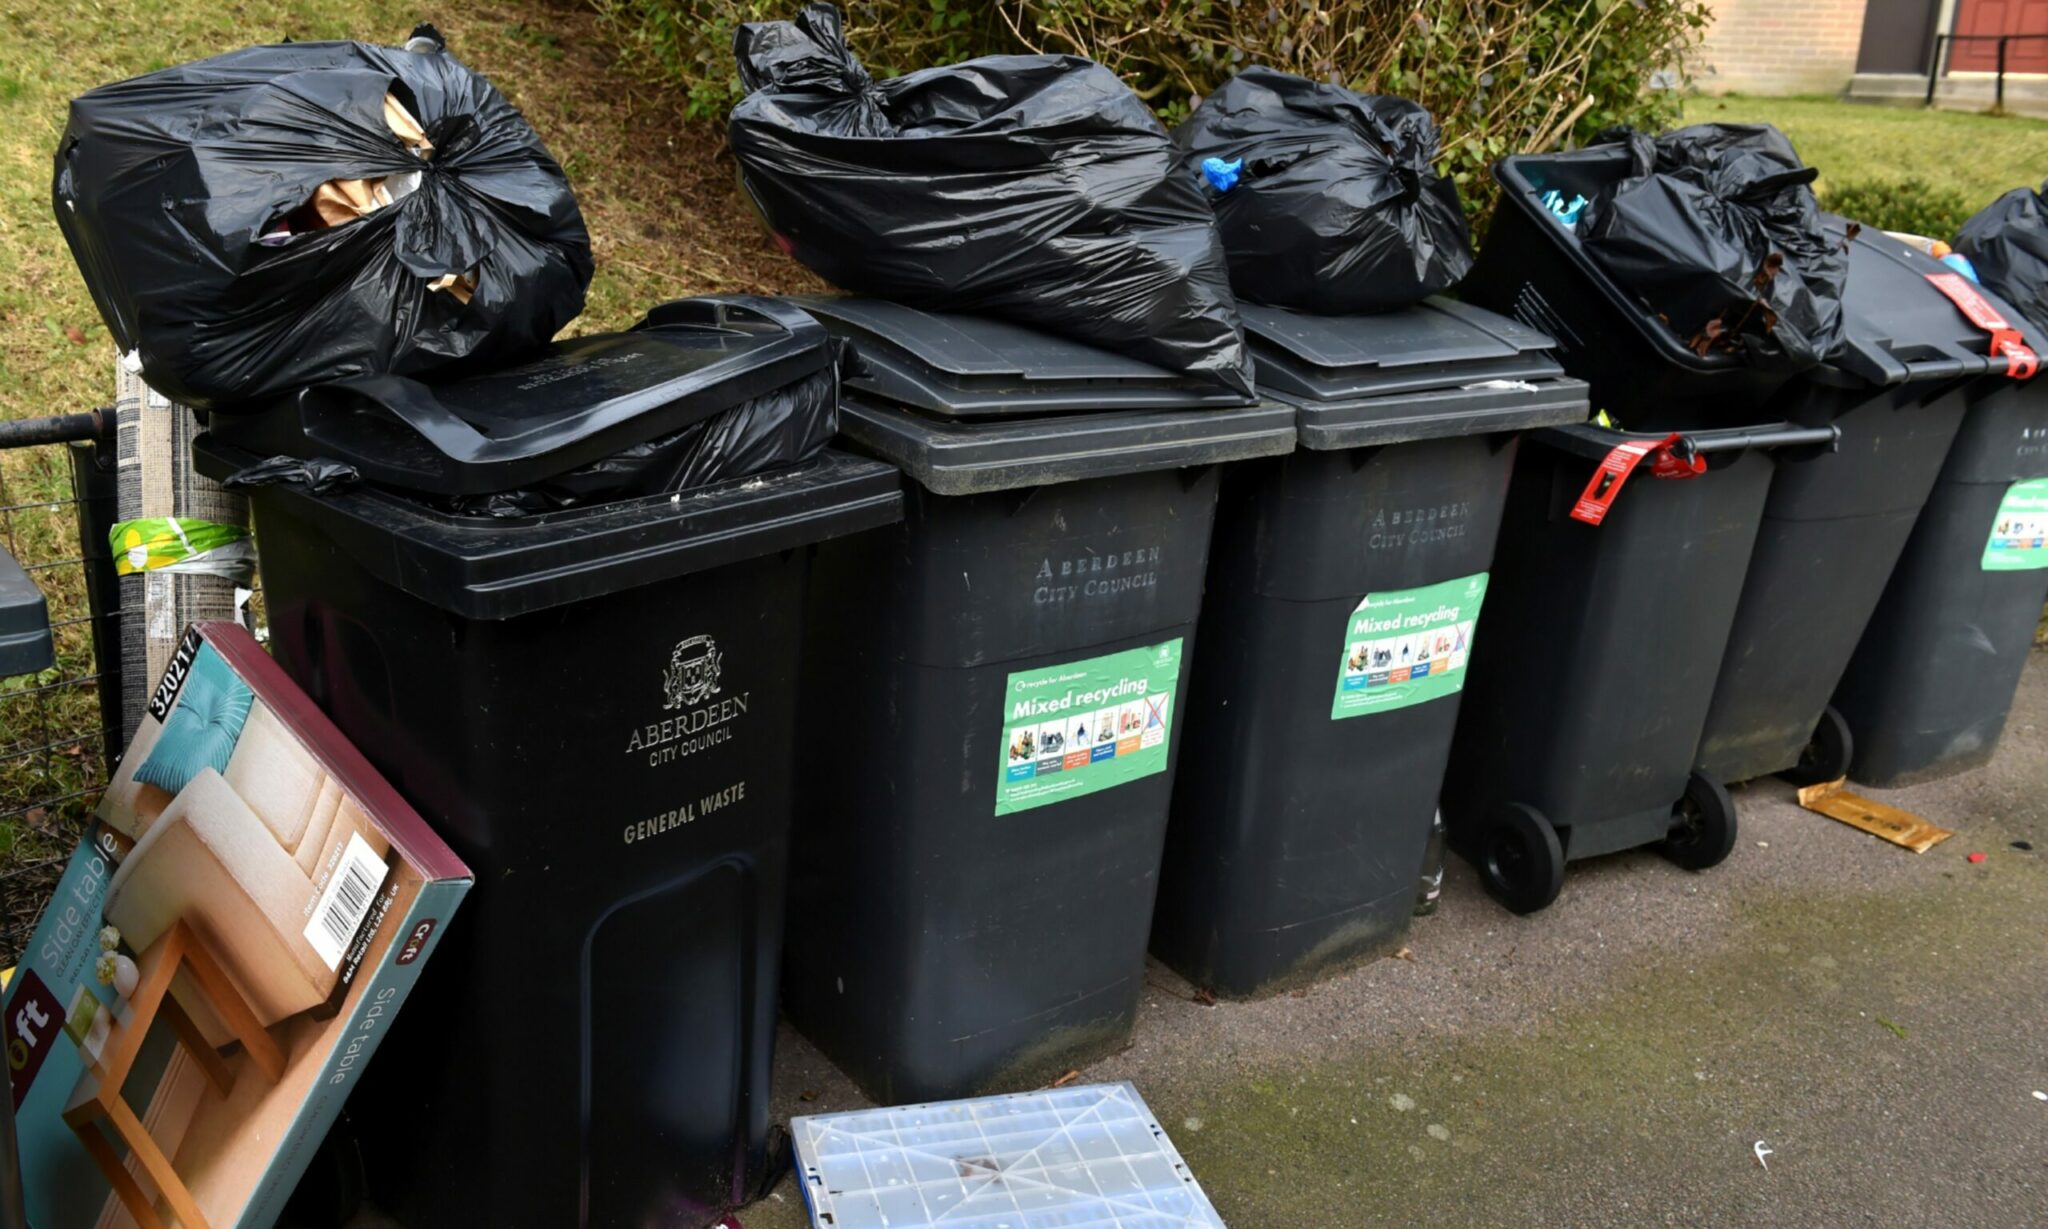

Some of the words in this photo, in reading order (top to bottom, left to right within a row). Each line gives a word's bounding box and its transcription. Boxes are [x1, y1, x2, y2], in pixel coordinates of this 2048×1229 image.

[1035, 546, 1160, 579] ABERDEEN
[1033, 585, 1078, 605] CITY
[1084, 571, 1158, 597] COUNCIL
[1354, 612, 1402, 635] Mixed
[1403, 604, 1460, 628] recycling
[151, 635, 195, 716] 320217
[1012, 690, 1073, 719] Mixed
[1075, 677, 1149, 706] recycling
[625, 691, 750, 753] ABERDEEN
[649, 744, 678, 767] CITY
[681, 726, 733, 757] COUNCIL
[624, 803, 696, 844] GENERAL
[700, 781, 746, 816] WASTE
[41, 906, 81, 968] Side
[72, 832, 118, 904] table
[401, 923, 430, 961] Croft
[360, 987, 396, 1030] Side
[9, 999, 50, 1088] oft
[329, 1032, 369, 1085] table
